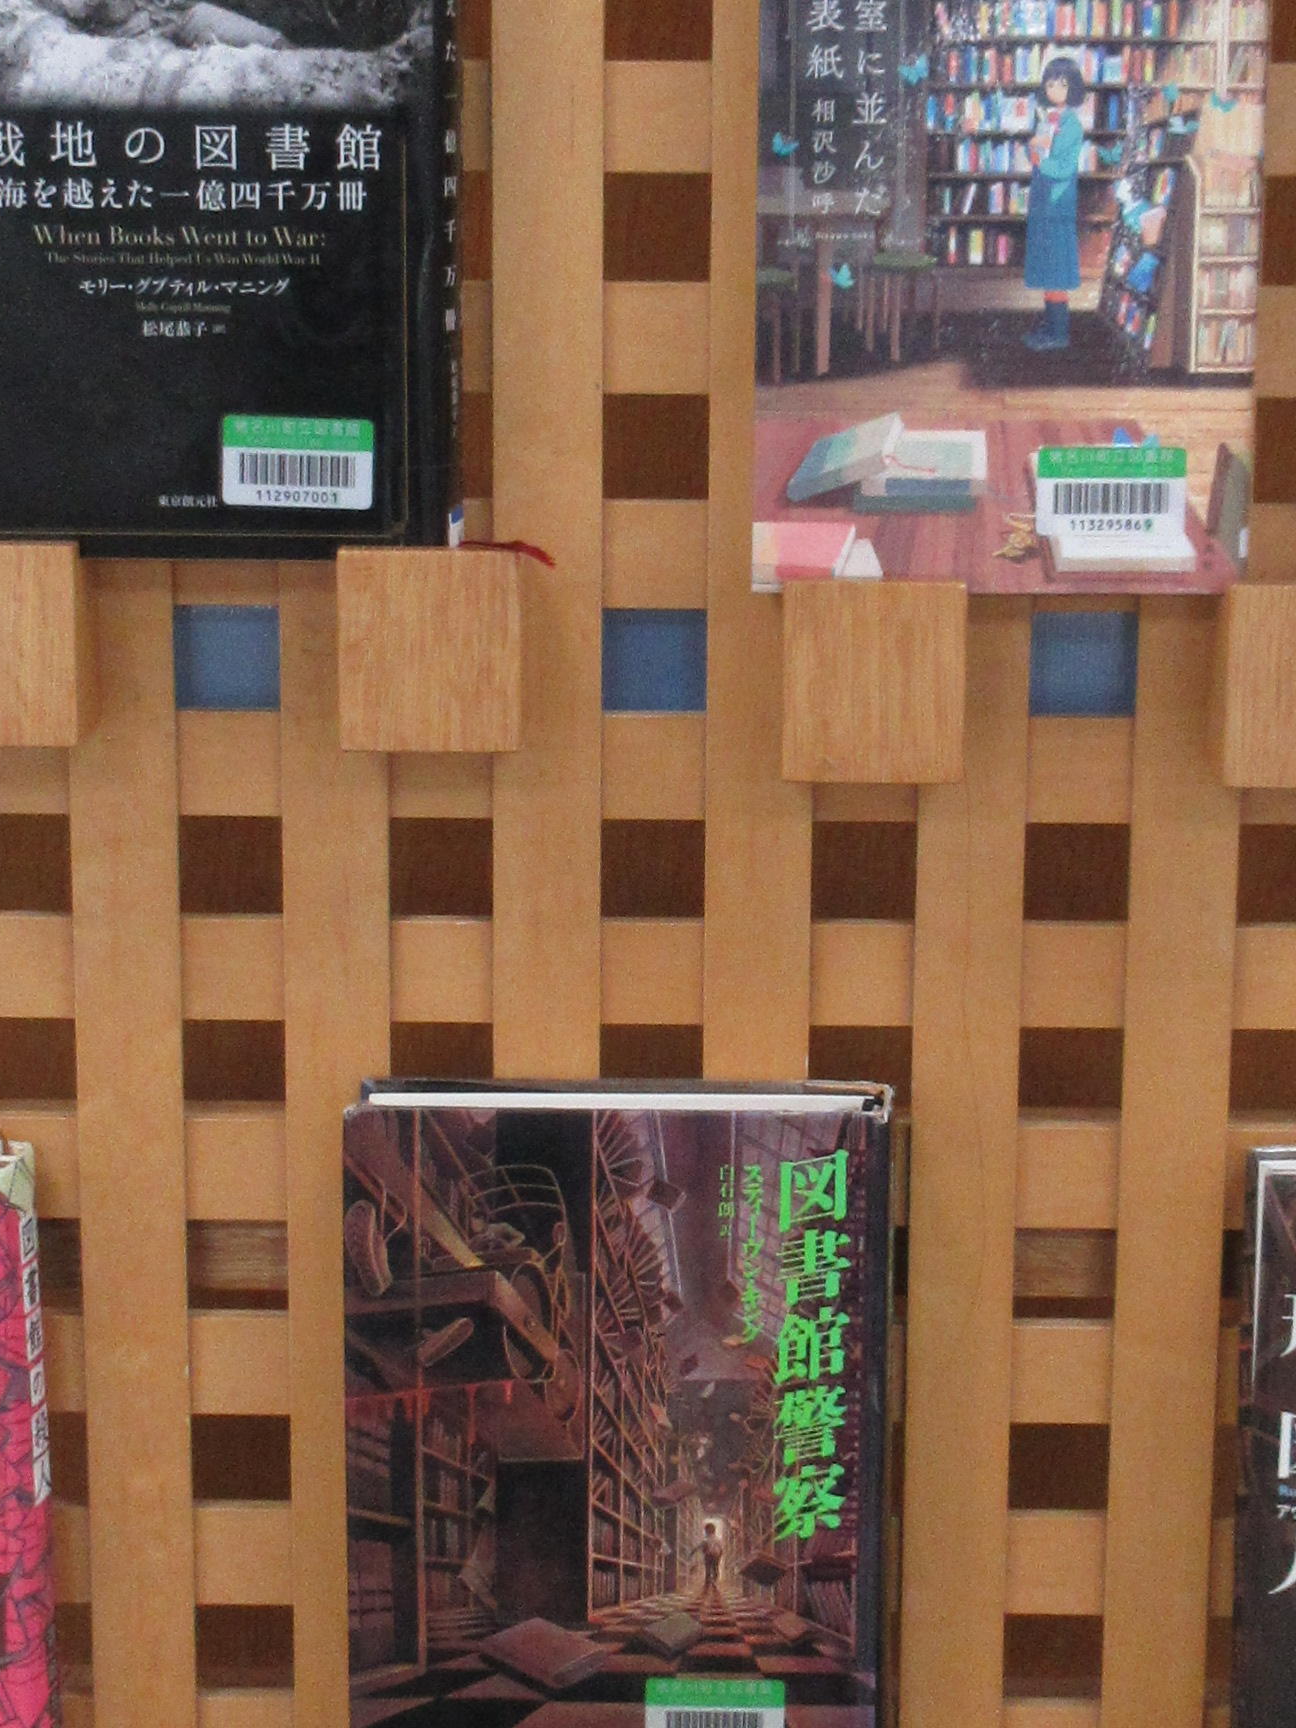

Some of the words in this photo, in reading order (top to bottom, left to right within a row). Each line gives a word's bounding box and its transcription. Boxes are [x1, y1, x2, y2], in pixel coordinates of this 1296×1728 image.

[33, 225, 101, 245] When
[109, 224, 175, 246] Books
[183, 226, 237, 246] Went
[246, 228, 267, 245] to
[256, 489, 339, 504] 112907001
[1070, 519, 1153, 532] 113295869
[772, 1149, 853, 1543] 図書館警察
